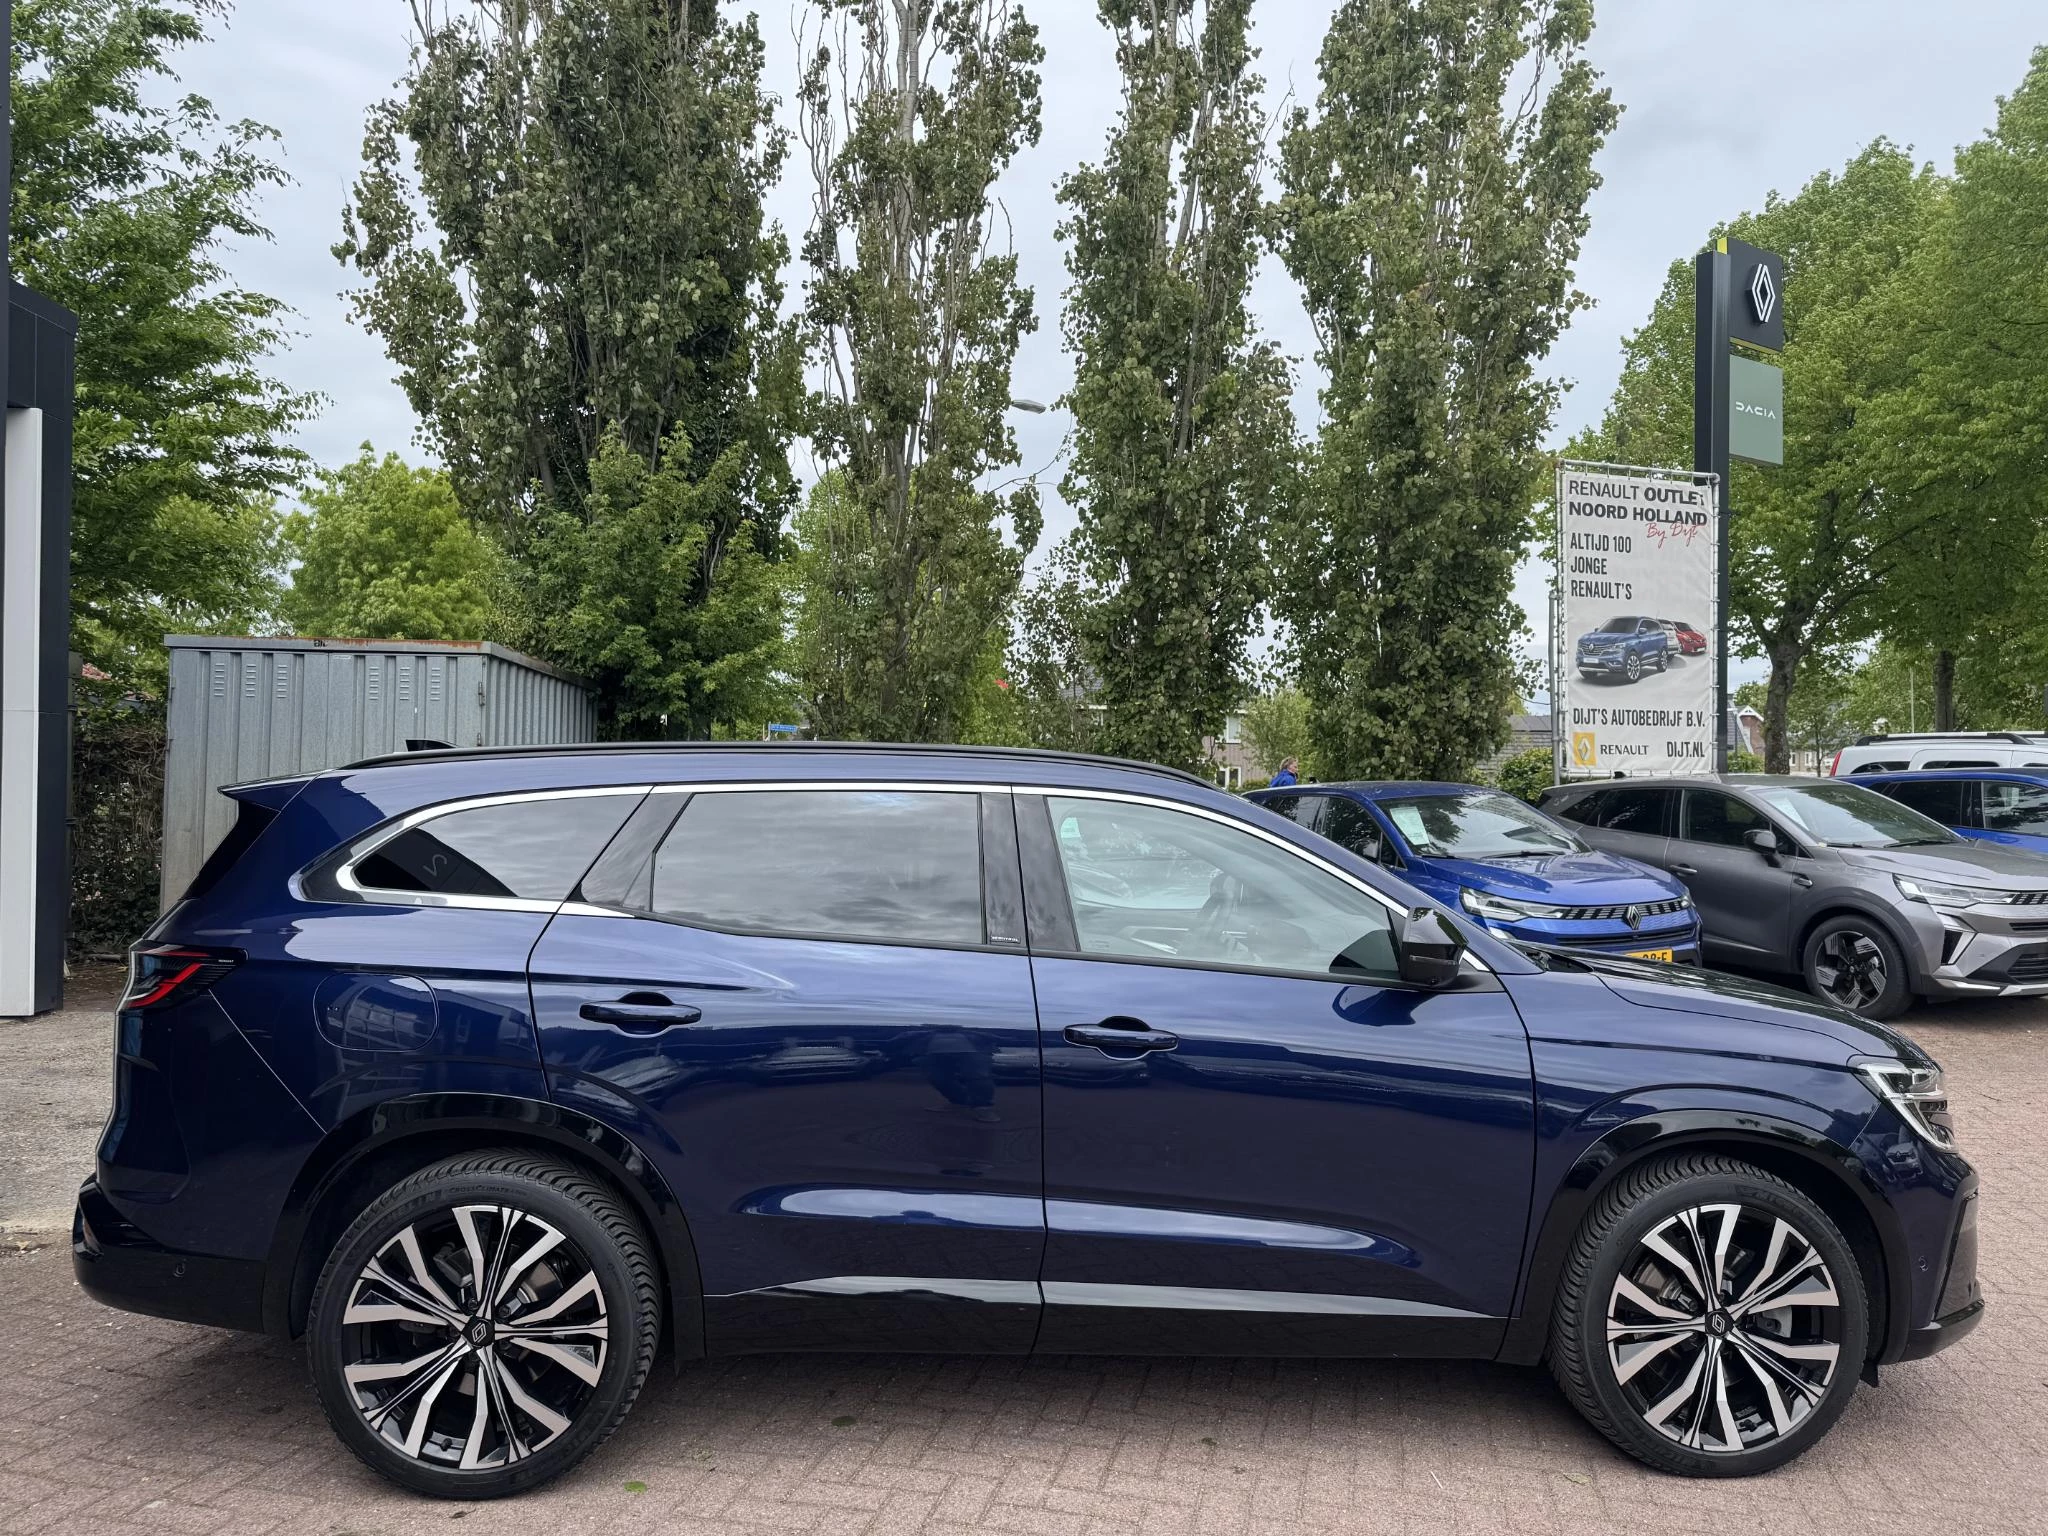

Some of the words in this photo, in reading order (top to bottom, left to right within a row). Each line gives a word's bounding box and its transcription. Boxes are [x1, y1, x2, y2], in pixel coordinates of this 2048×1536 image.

[1735, 401, 1776, 419] DACIA
[1569, 480, 1639, 500] RENAULT
[1569, 501, 1628, 520] NOORD
[1633, 507, 1708, 526] HOLLAND
[1570, 532, 1609, 552] ALTIJD
[1613, 536, 1632, 553] 100
[1645, 522, 1667, 549] By
[1570, 556, 1608, 575] JONGE
[1571, 580, 1632, 600] RENAULT'S
[1573, 707, 1608, 725] DIJT'S
[1611, 709, 1683, 727] AUTOBEDRIJF
[1686, 711, 1705, 727] B.V.
[1600, 744, 1649, 755] RENAULT
[1666, 741, 1705, 758] DIJT.NL
